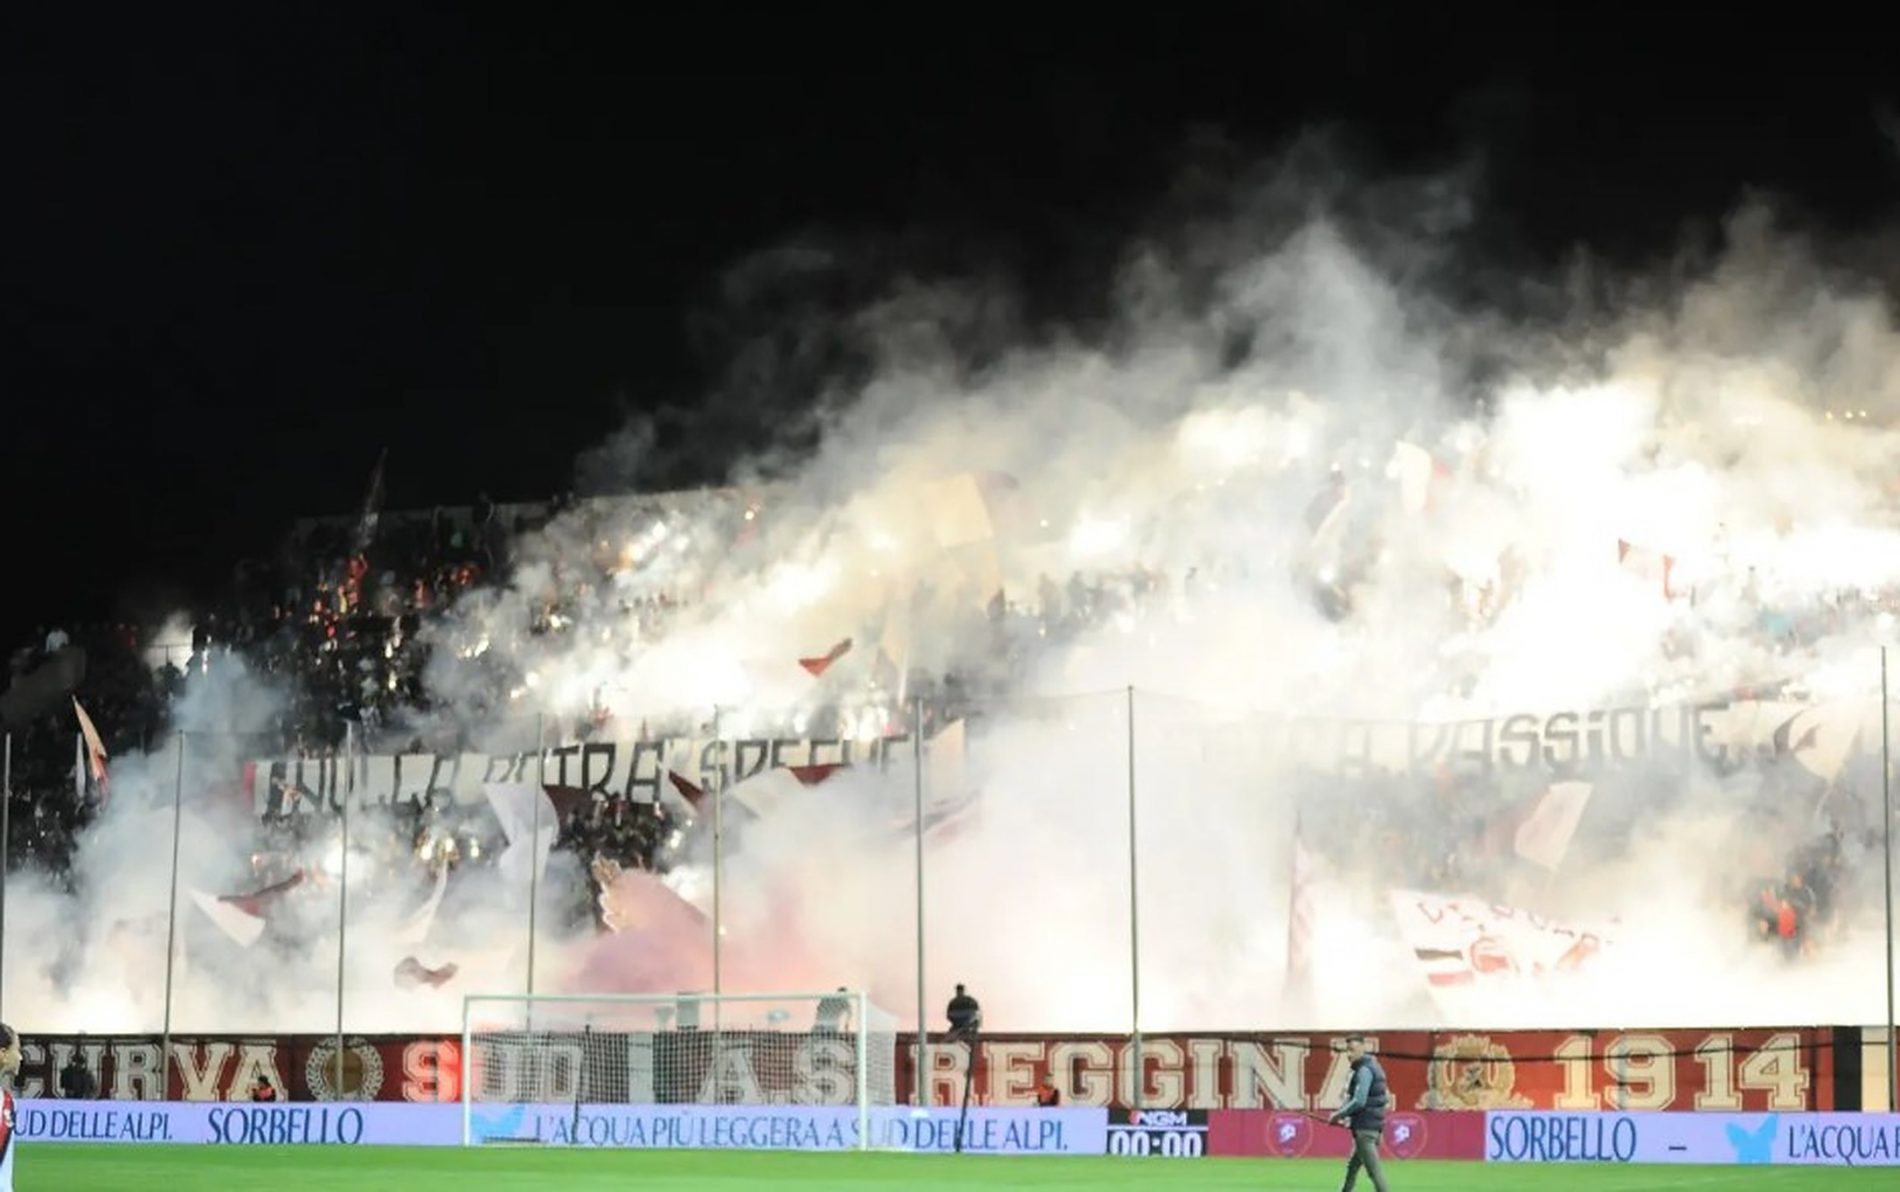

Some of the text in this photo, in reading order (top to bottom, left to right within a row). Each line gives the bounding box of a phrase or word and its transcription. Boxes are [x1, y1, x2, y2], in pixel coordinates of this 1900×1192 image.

[18, 1041, 287, 1101] CURVA
[912, 1038, 1396, 1109] REGGINA
[1554, 1033, 1809, 1110] 1914
[14, 1110, 172, 1140] UD DELLE ALPI.
[207, 1108, 364, 1144] SORBELLO
[700, 1116, 820, 1147] LEGGERA
[825, 1117, 845, 1147] A
[914, 1120, 1003, 1151] DELLE
[1004, 1121, 1068, 1152] ALPI.
[1490, 1116, 1637, 1162] SORBELLO
[1789, 1124, 1890, 1167] L'ACQUA
